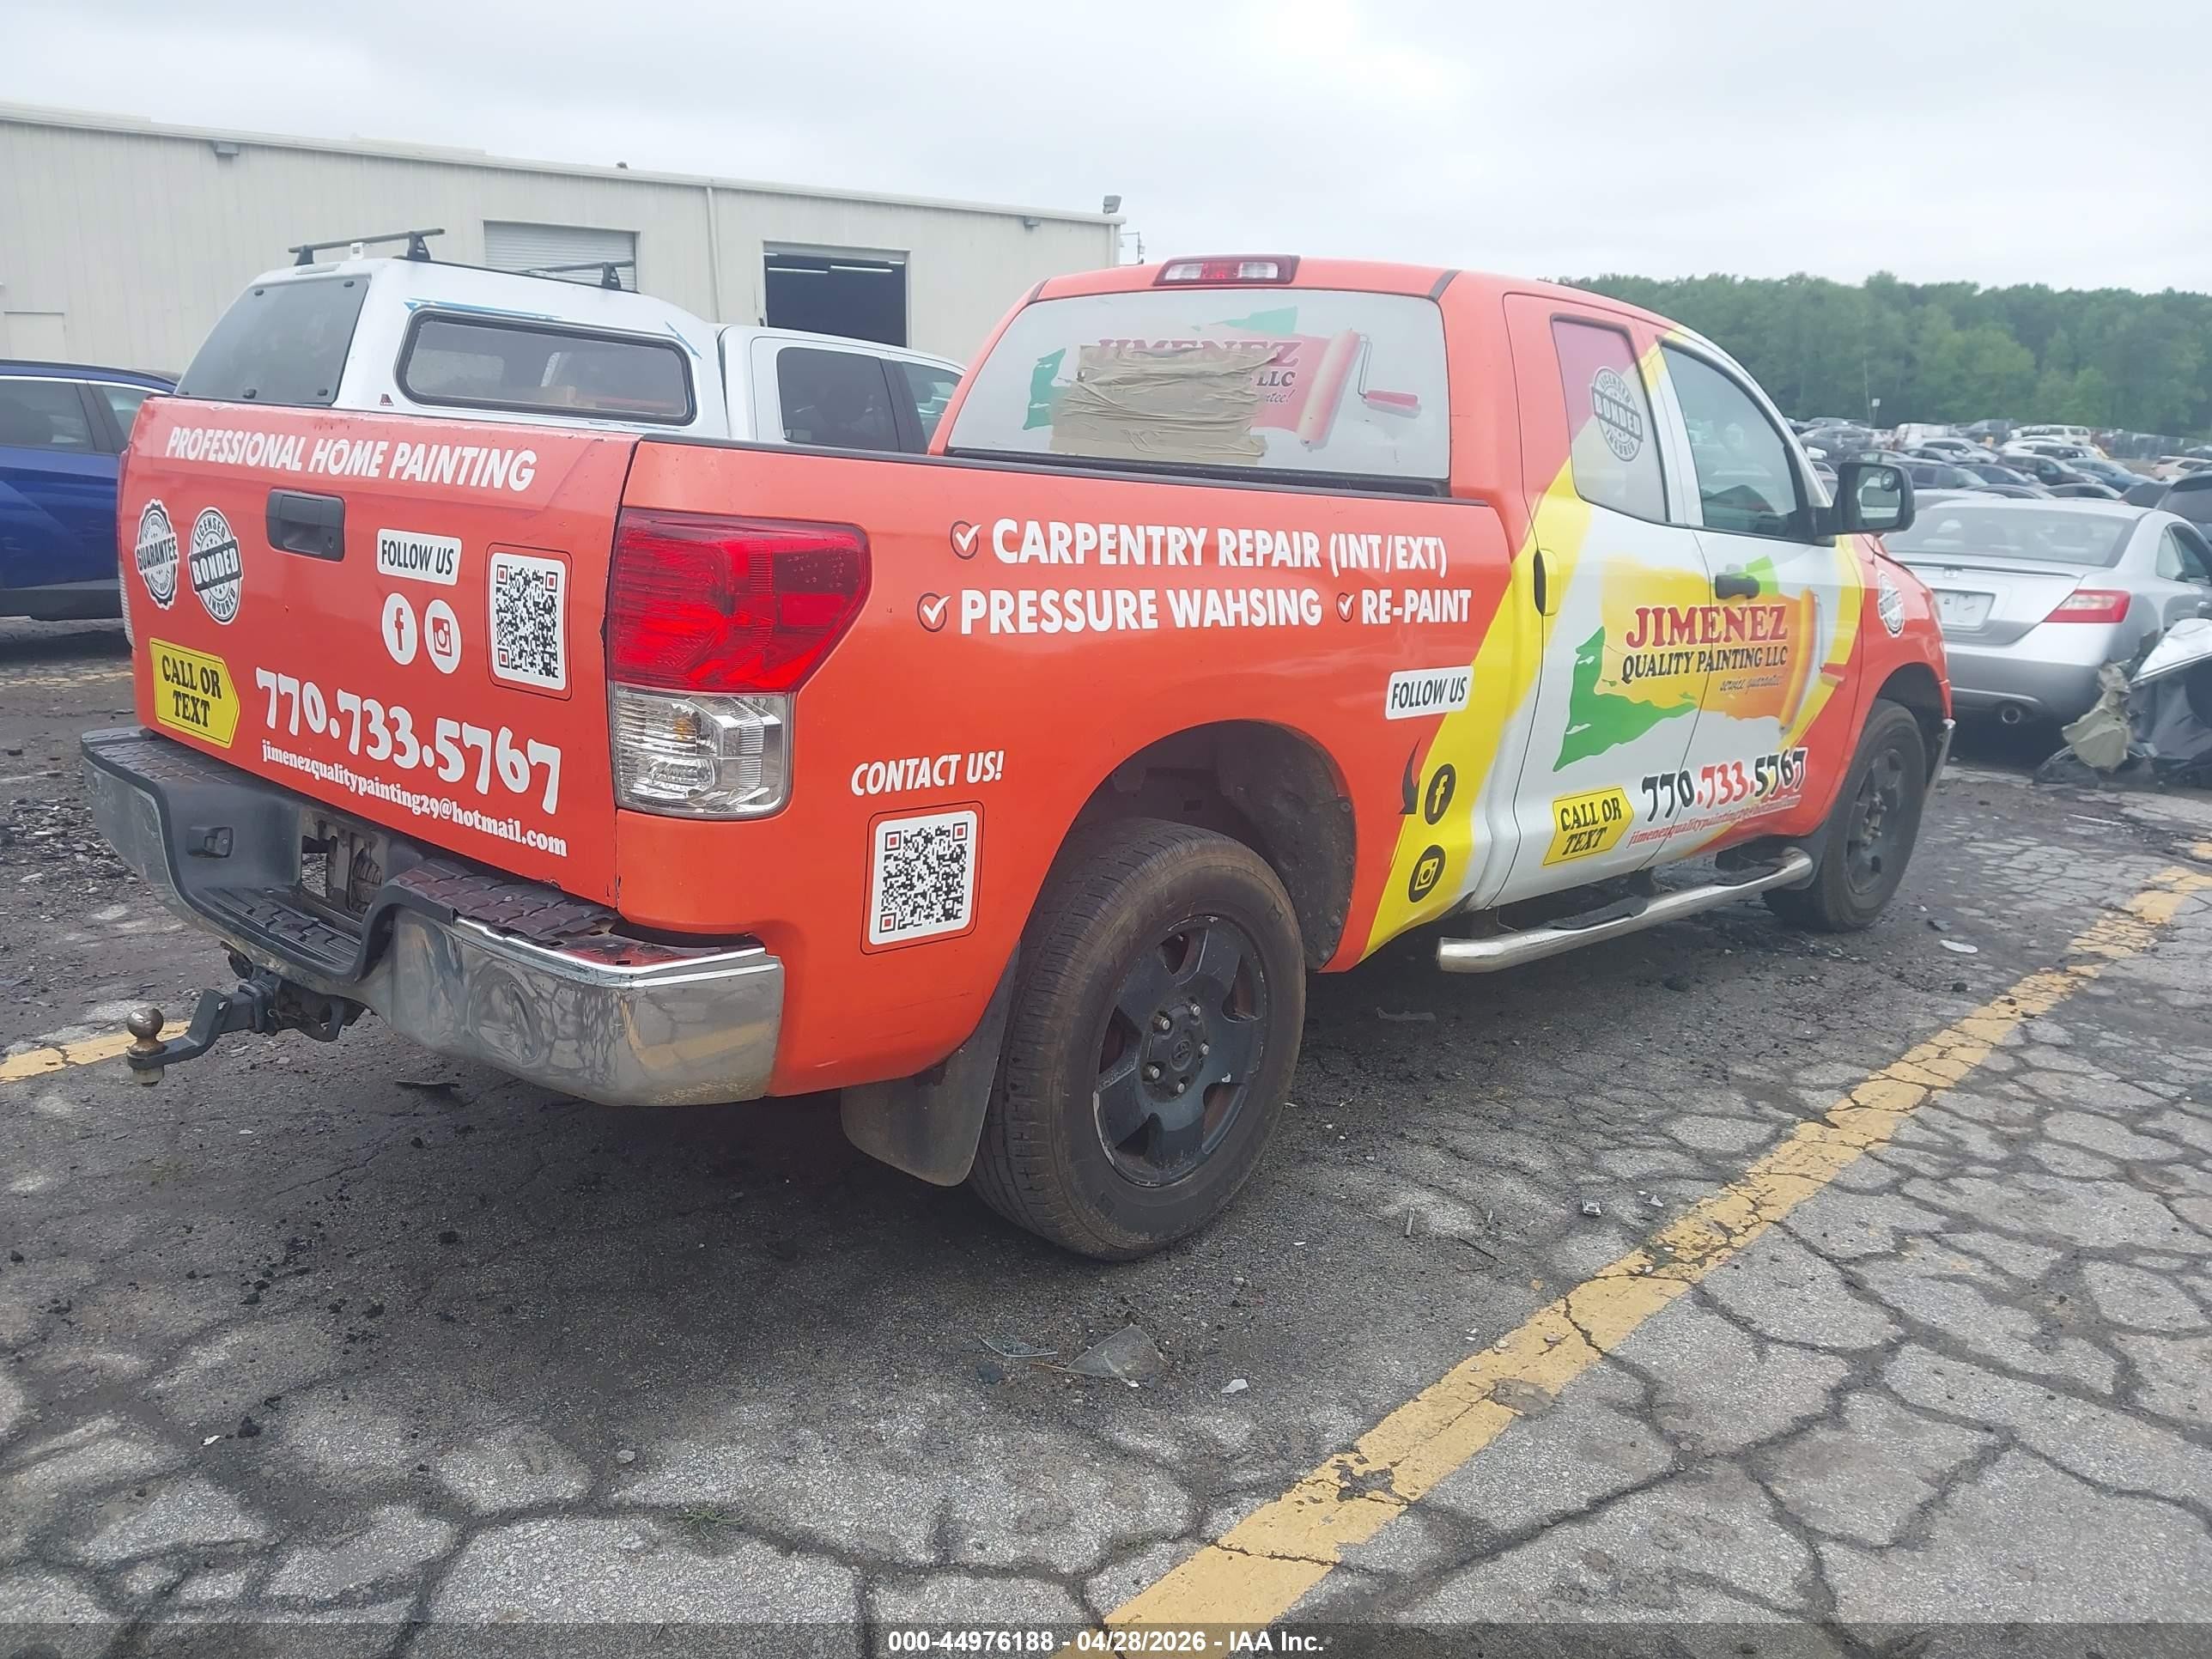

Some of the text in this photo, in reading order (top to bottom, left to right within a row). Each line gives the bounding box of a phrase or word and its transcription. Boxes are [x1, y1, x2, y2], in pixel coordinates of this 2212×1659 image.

[1595, 392, 1642, 437] BONDED
[166, 426, 538, 492] PROFESSIONAL HOME PAINTING
[195, 516, 226, 547] LICENSED
[993, 520, 1448, 577] CARPENTRY REPAIR (INT/EXT)
[137, 536, 178, 572] GUARANTEE
[191, 547, 239, 586] BONDED
[380, 539, 454, 576] FOLLOW US
[209, 587, 236, 615] INSURED
[961, 588, 1472, 635] PRESSURE WAHSING RE-PAINT
[1626, 605, 1788, 647] JIMENEZ
[161, 655, 222, 699] CALL OR
[1621, 652, 1694, 684] QUALITY
[1697, 647, 1761, 672] PAINTING
[1765, 646, 1788, 666] LLC
[173, 692, 210, 727] TEXT
[1391, 675, 1468, 711] FOLLOW US
[256, 666, 562, 815] 770.733.5767
[851, 750, 1005, 796] CONTACT US!
[1641, 750, 1807, 822] 770.733.5767
[262, 738, 568, 857] jimenezqualitypainting29@hotmail.com
[1560, 798, 1622, 831] CALL OR
[1562, 828, 1608, 855] TEXT
